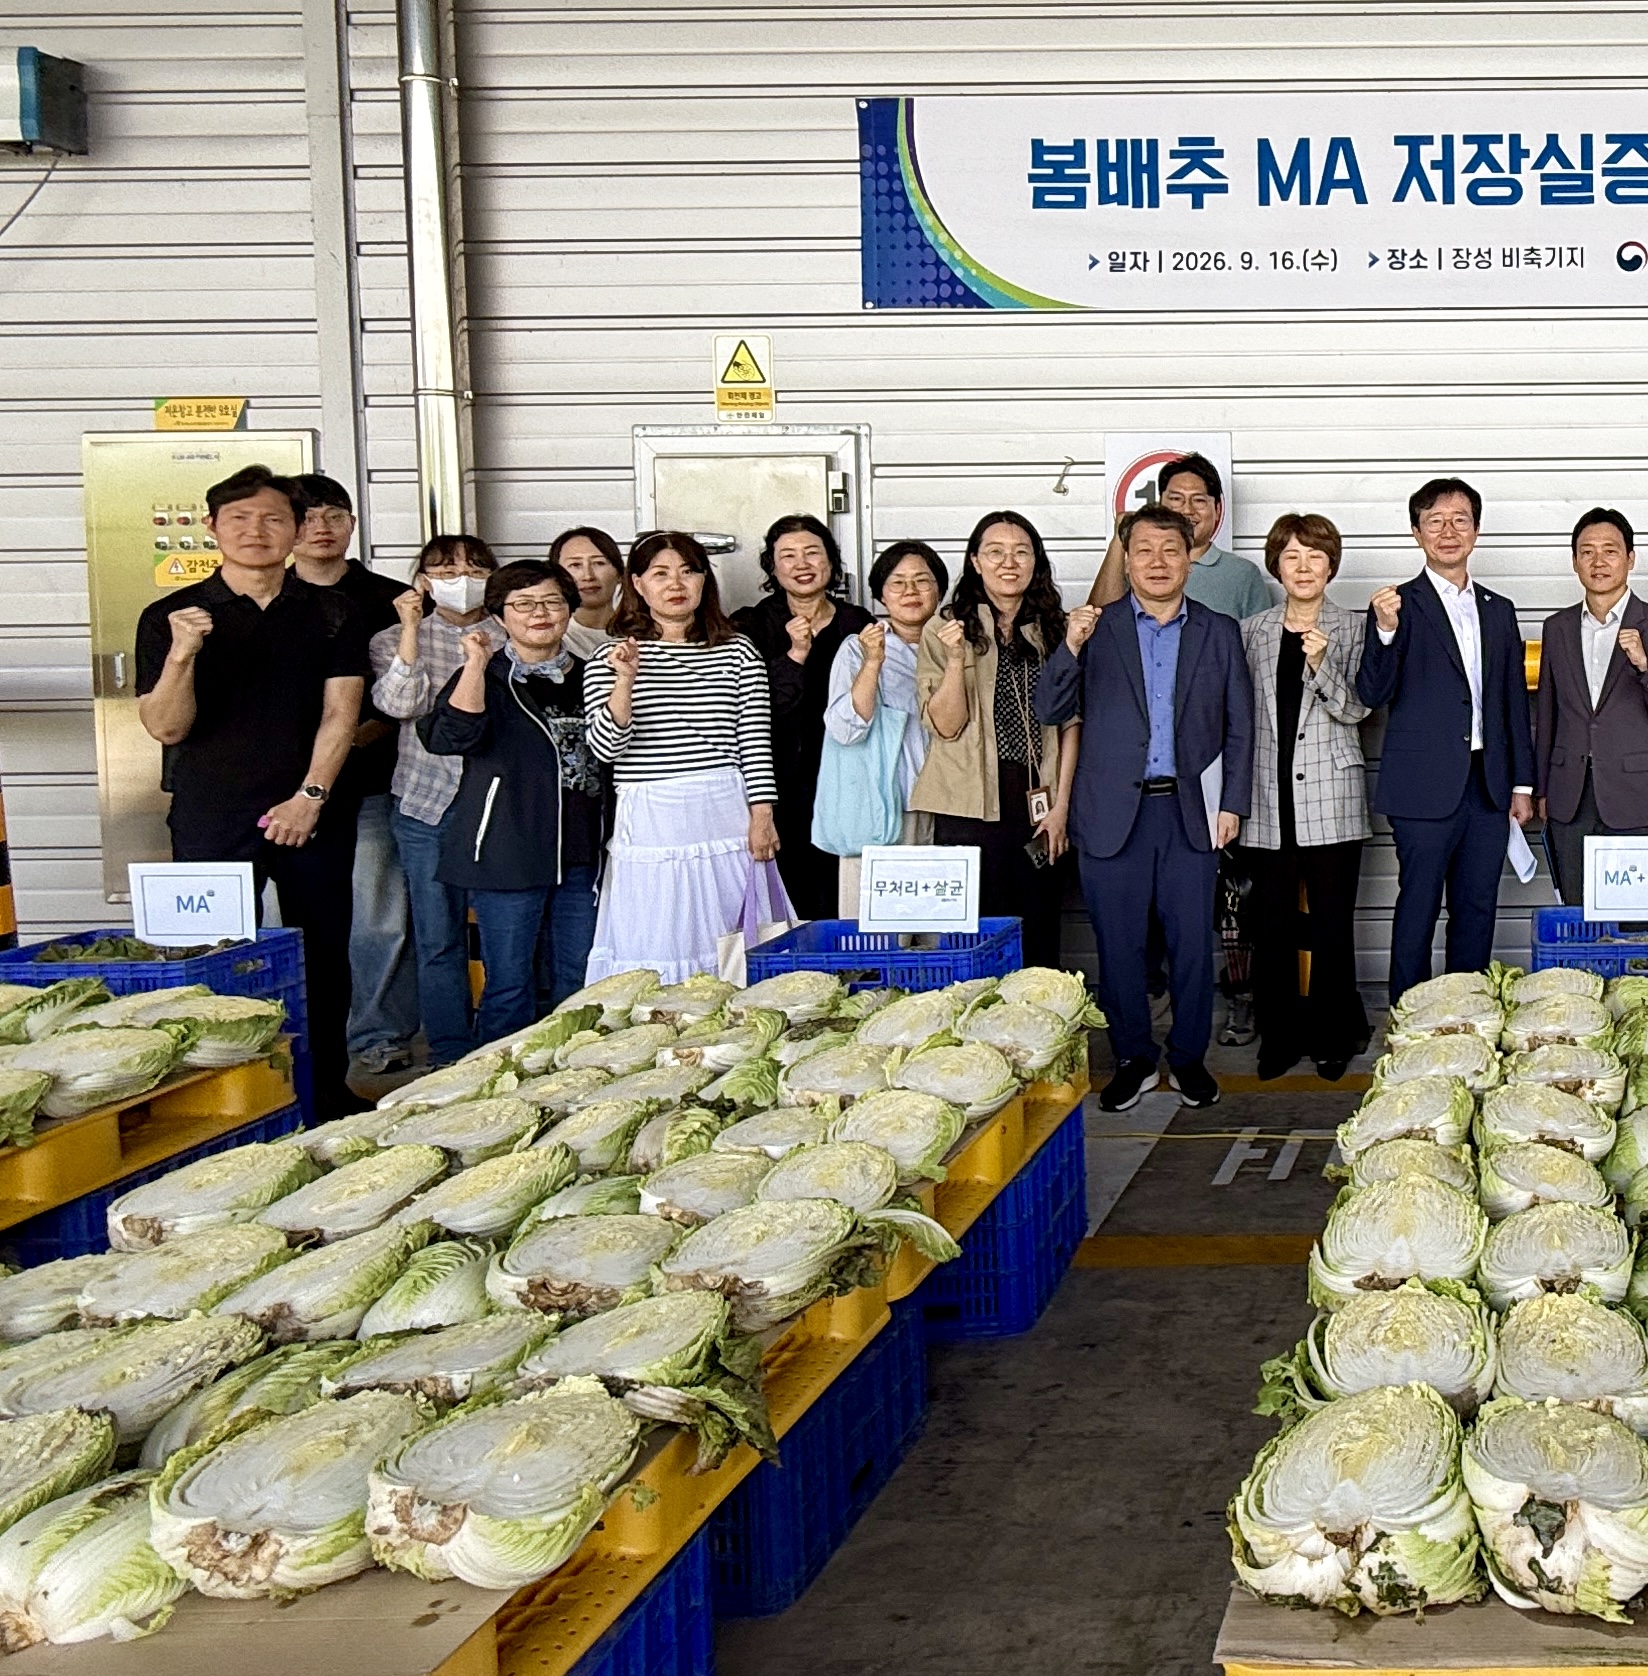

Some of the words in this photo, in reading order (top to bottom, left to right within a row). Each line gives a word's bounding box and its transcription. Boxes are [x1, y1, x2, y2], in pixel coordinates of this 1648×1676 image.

[1028, 136, 1229, 210] 봄배추
[1257, 136, 1369, 207] MA
[1108, 251, 1150, 273] 일자
[1172, 251, 1232, 271] 2026.
[1240, 251, 1259, 271] 9.
[1269, 249, 1338, 273] 16.(수)
[1387, 248, 1428, 271] 장소
[1452, 247, 1493, 271] 장성
[1502, 246, 1584, 270] 비축기지
